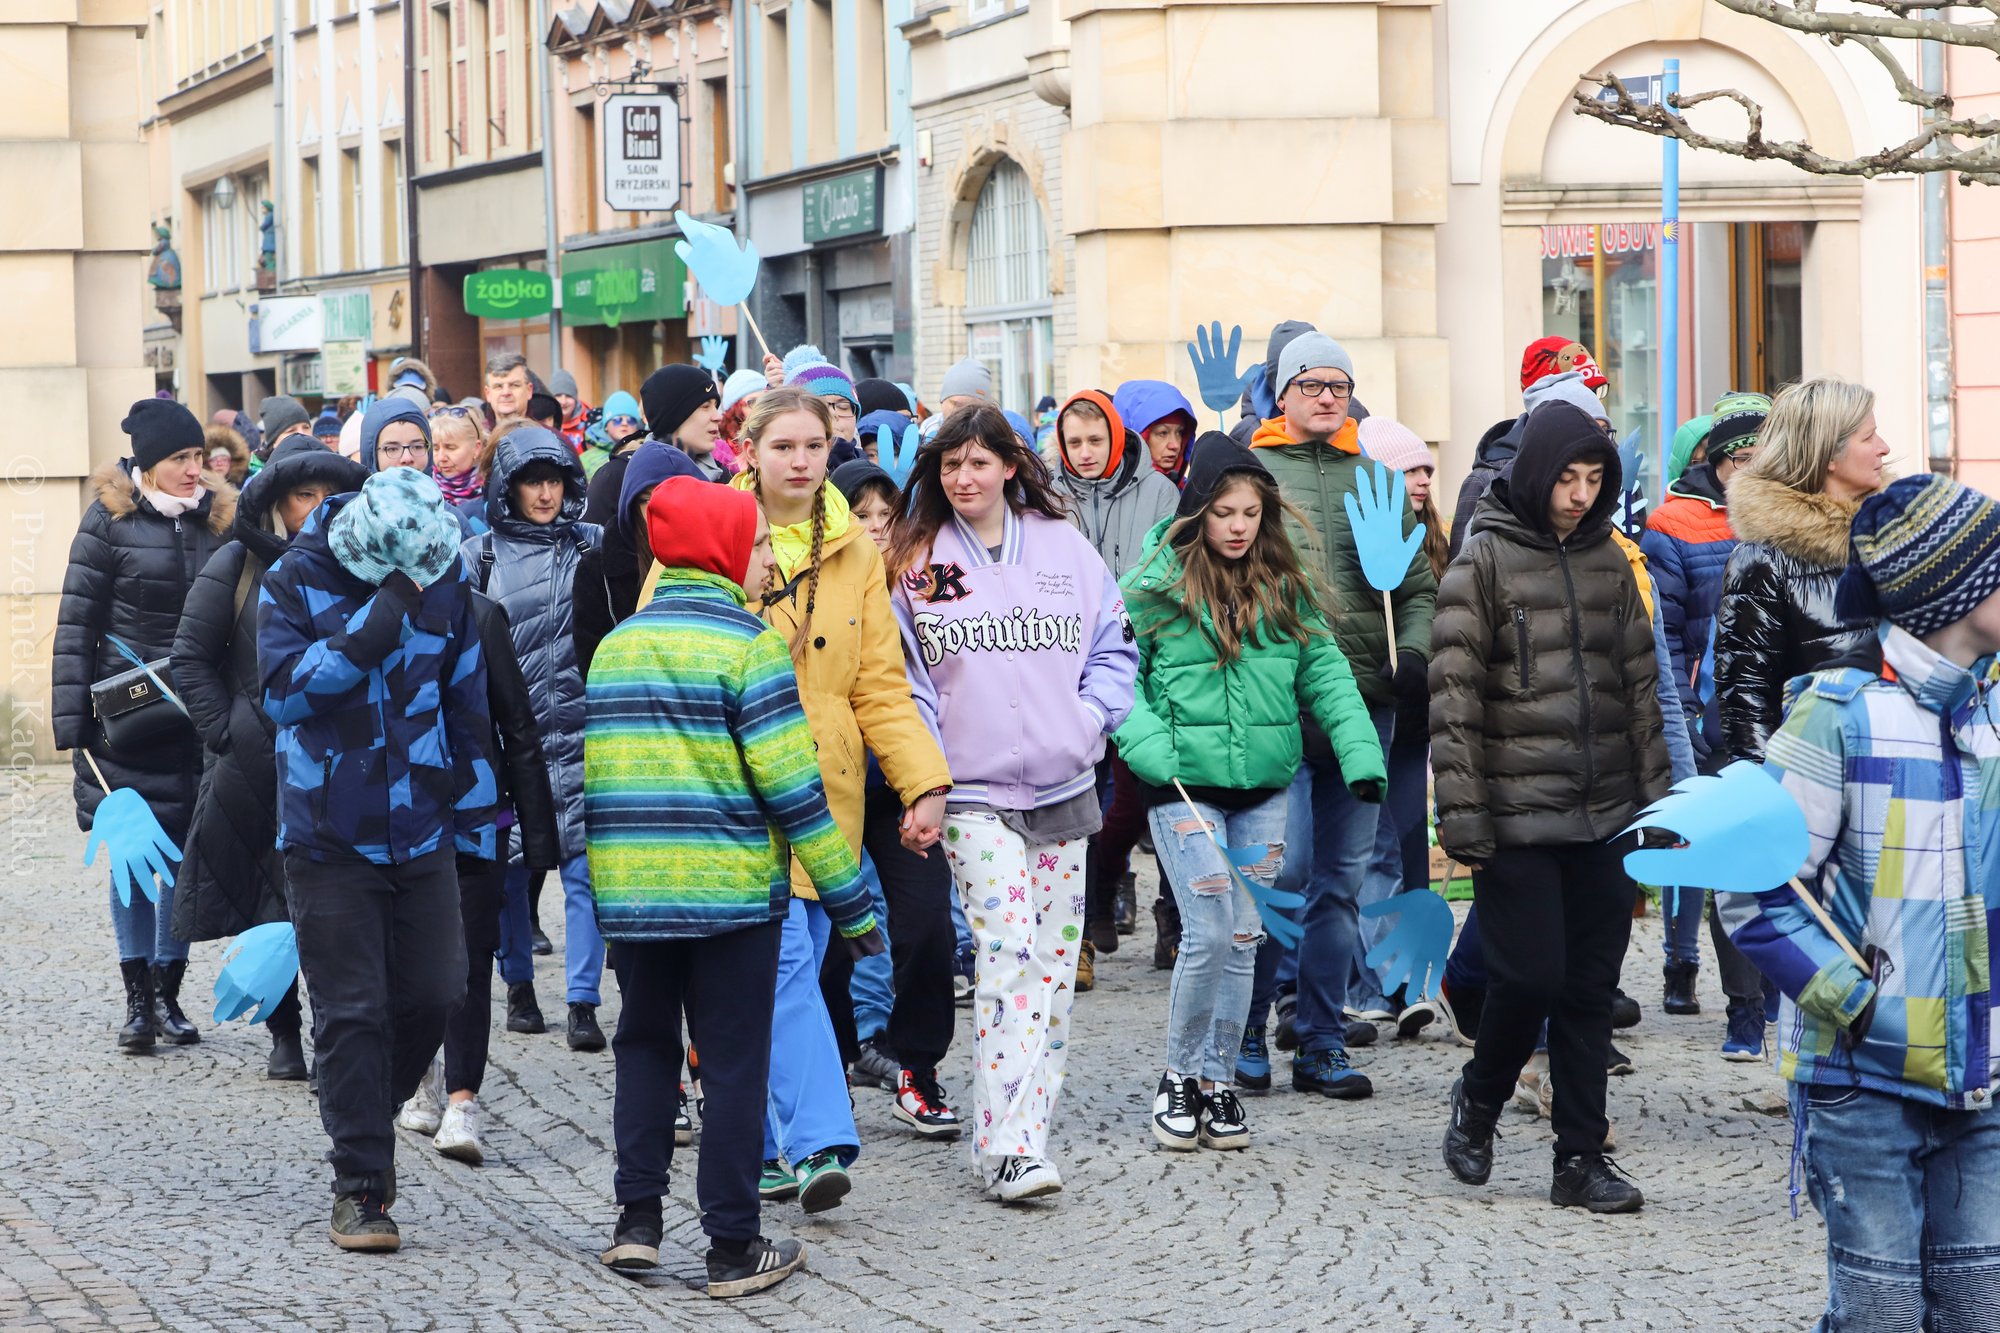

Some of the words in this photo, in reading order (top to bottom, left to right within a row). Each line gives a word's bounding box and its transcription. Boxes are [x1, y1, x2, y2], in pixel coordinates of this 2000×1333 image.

[626, 107, 658, 132] Carlo
[626, 133, 658, 158] Biani
[626, 164, 659, 175] SALON
[615, 179, 671, 190] FRYZJERSKI
[476, 279, 547, 299] żabka
[914, 606, 1081, 666] Fortuitous
